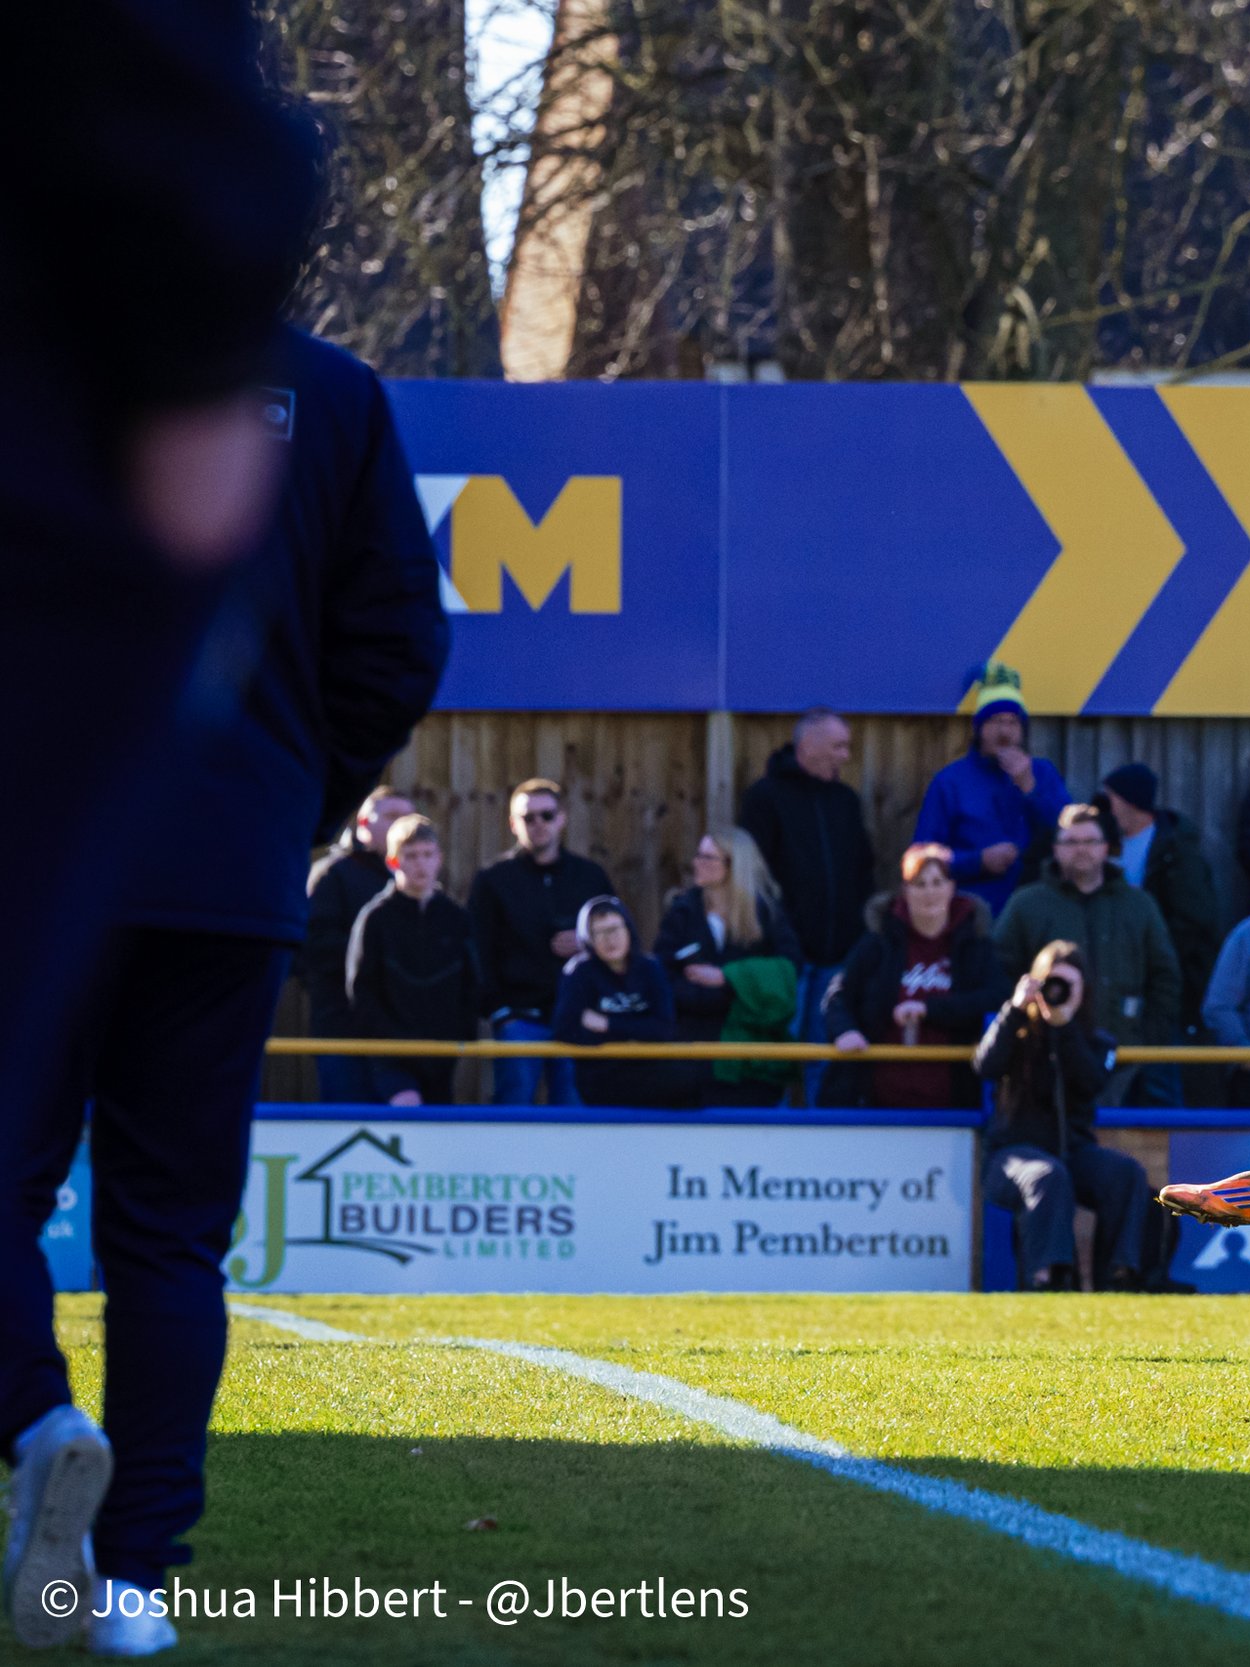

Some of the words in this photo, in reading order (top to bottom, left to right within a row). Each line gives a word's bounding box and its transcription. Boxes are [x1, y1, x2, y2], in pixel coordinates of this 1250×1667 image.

[341, 1173, 576, 1201] PEMBERTON
[667, 1165, 708, 1199] In
[721, 1165, 889, 1212] Memory
[900, 1166, 943, 1200] of
[228, 1154, 300, 1288] J
[339, 1204, 576, 1236] BUILDERS
[442, 1238, 576, 1259] LIMITED
[644, 1219, 721, 1265] Jim
[733, 1220, 949, 1257] Pemberton
